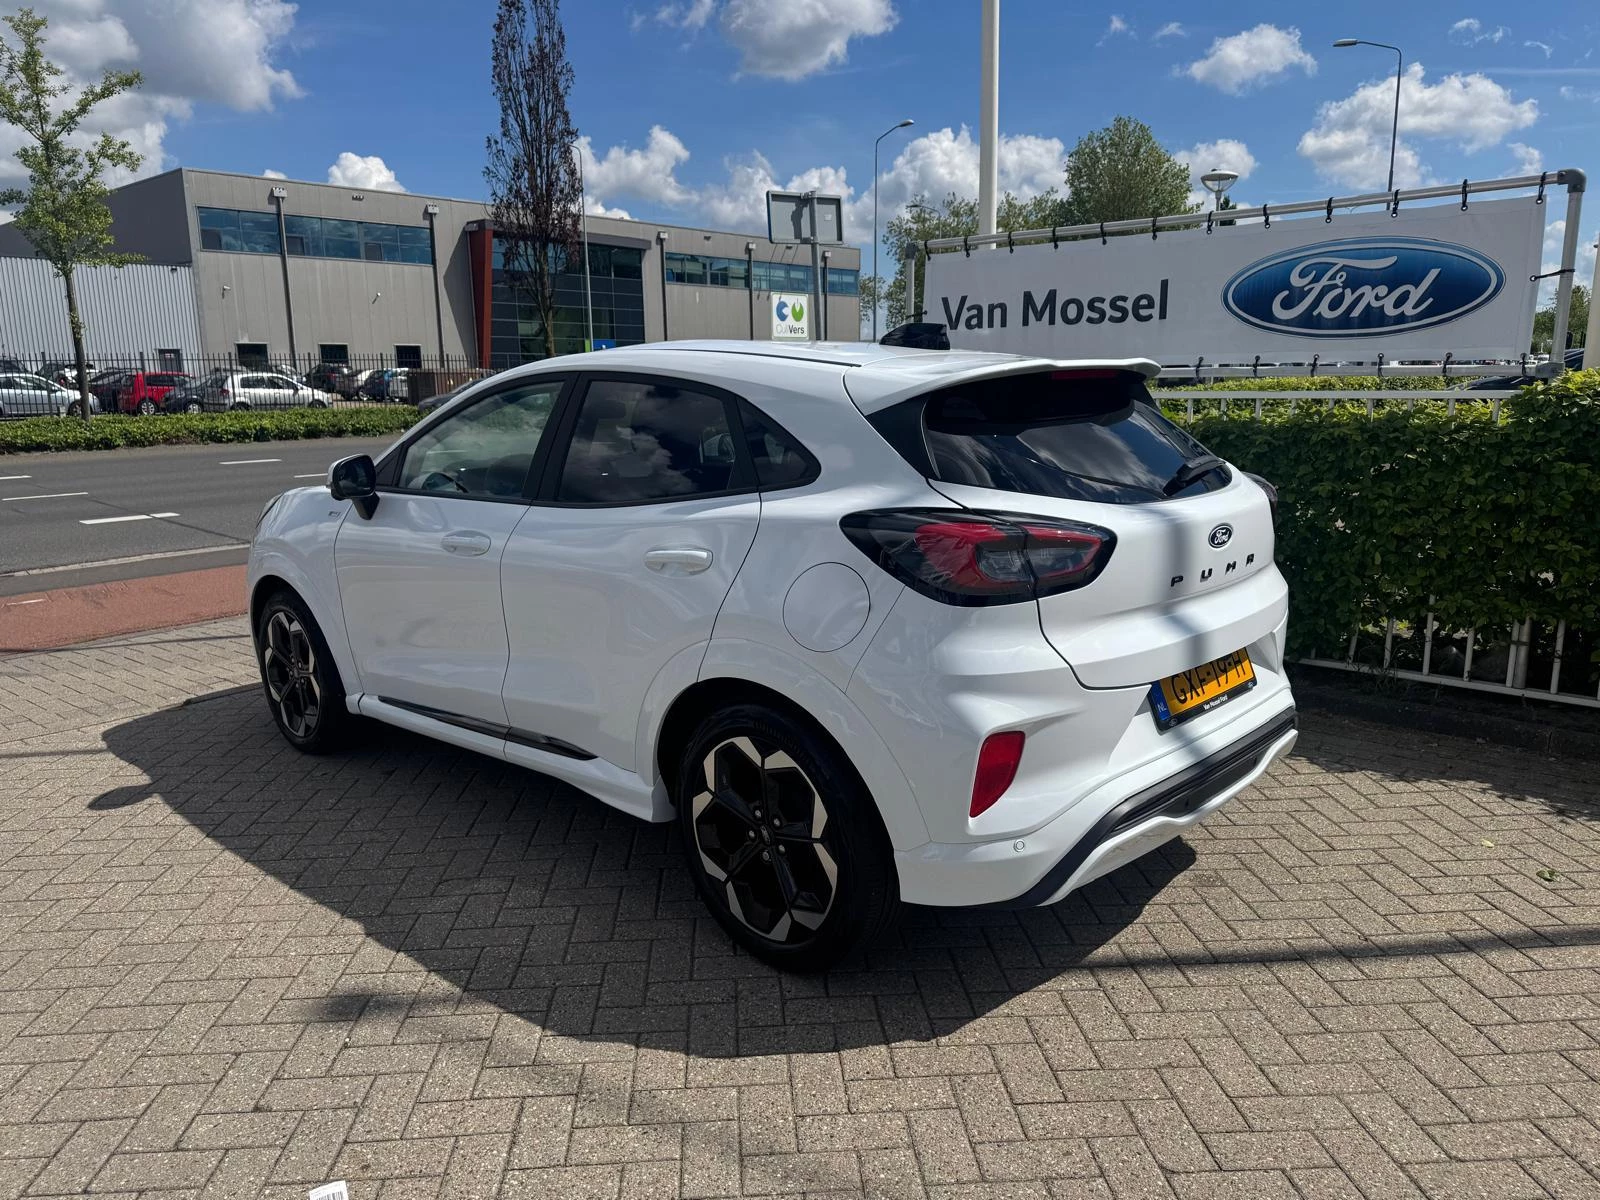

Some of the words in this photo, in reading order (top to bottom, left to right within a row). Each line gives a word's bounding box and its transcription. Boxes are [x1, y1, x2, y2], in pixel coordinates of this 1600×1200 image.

[941, 295, 1008, 330] Van
[1021, 278, 1169, 327] Mossel
[1271, 255, 1442, 320] Ford
[1171, 651, 1246, 704] GXF-19-H
[1157, 702, 1168, 713] NL
